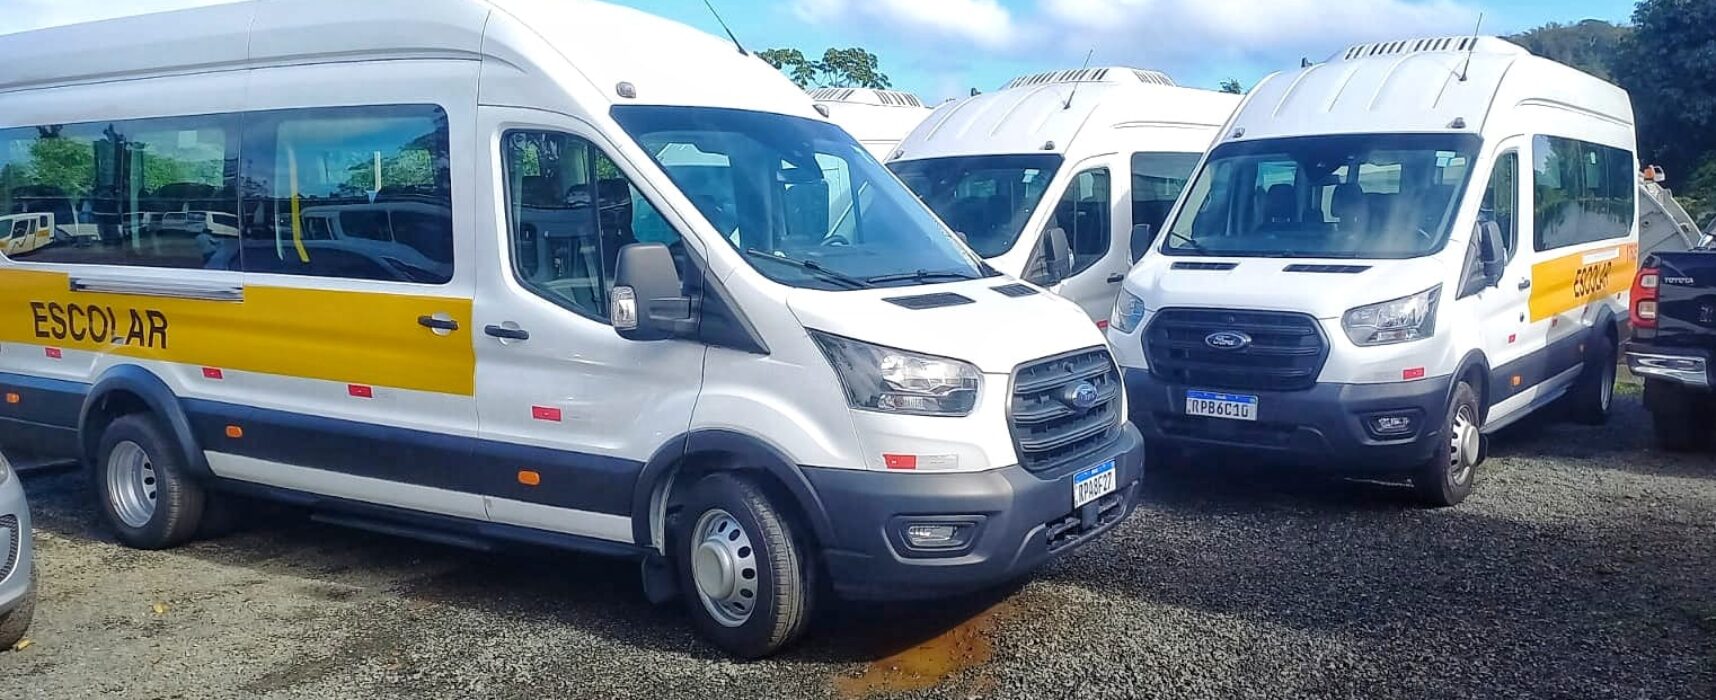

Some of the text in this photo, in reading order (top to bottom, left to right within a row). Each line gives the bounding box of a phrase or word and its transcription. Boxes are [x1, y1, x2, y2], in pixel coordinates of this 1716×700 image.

[1573, 261, 1612, 297] ESCOLAR
[1664, 276, 1694, 284] TOYOTA
[30, 301, 168, 349] ESCOLAR
